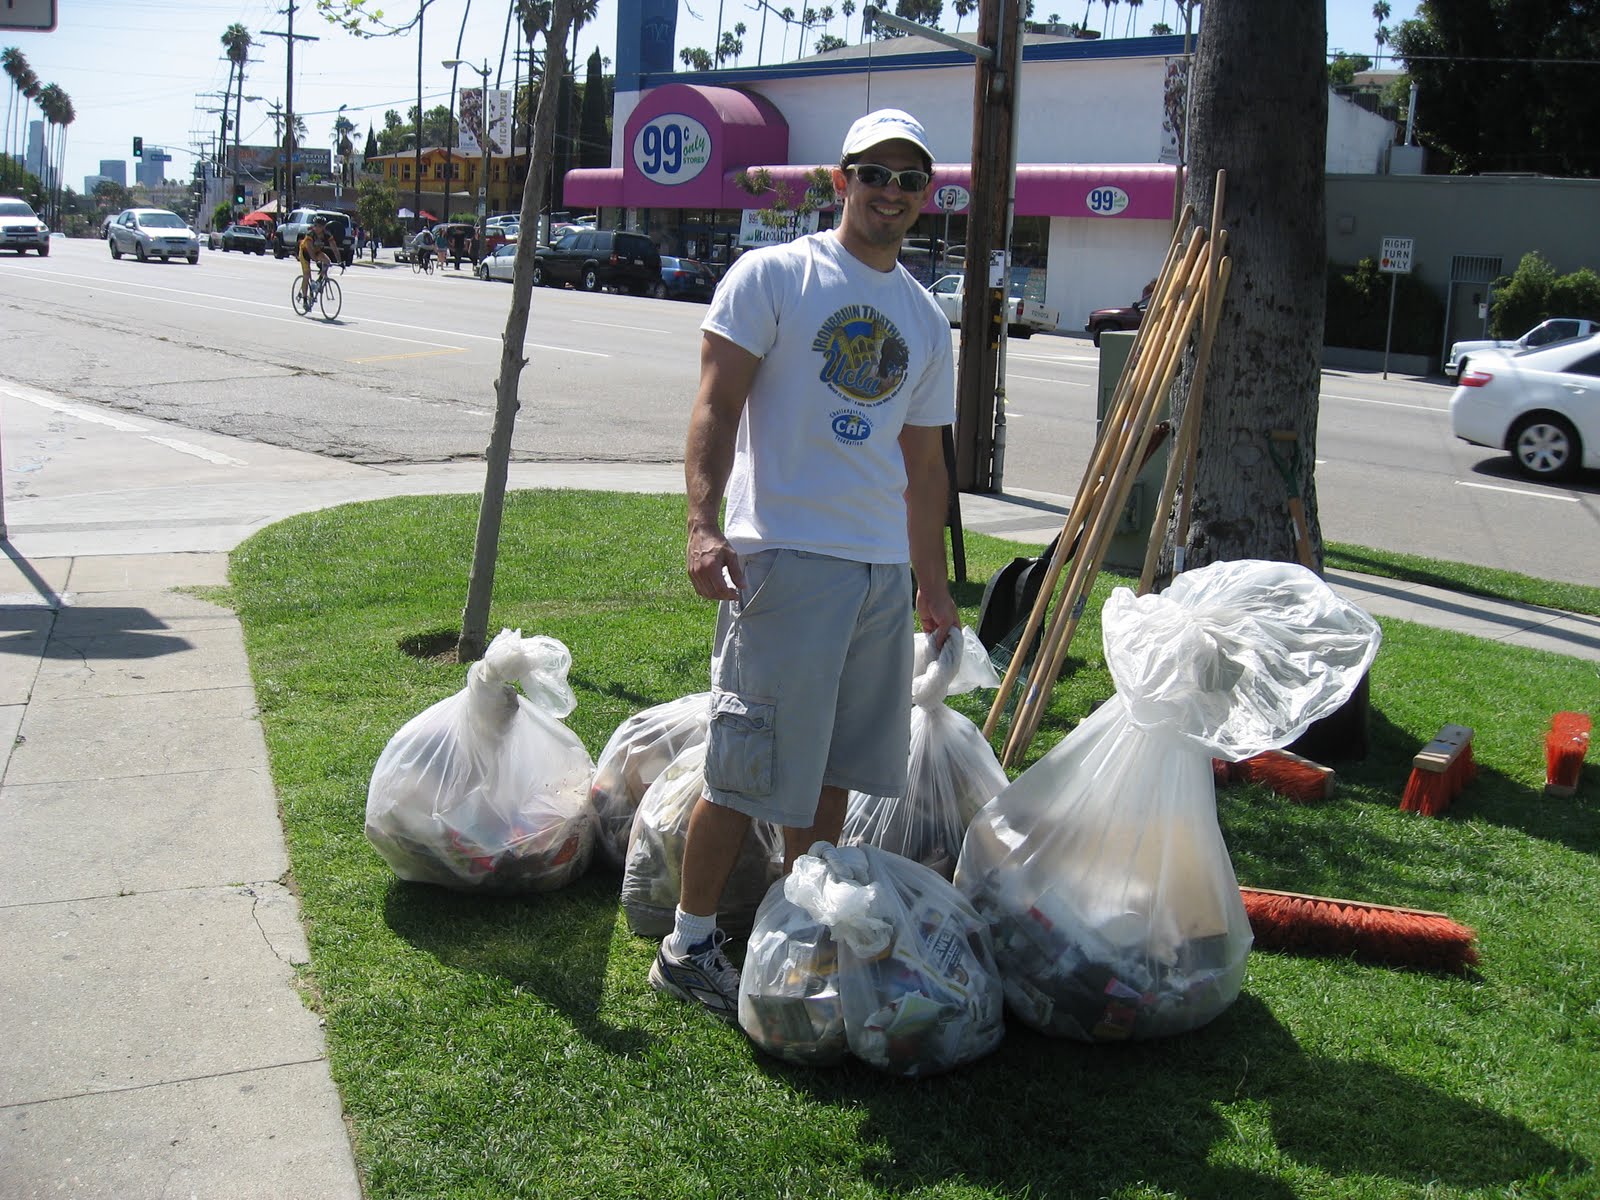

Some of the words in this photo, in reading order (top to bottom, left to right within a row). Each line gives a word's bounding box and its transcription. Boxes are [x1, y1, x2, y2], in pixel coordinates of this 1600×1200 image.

[500, 92, 508, 117] CAVE
[683, 134, 706, 156] only
[683, 156, 705, 165] STORES
[1384, 240, 1412, 249] RIGHT
[1384, 250, 1409, 259] TURN
[1382, 258, 1408, 269] NLY
[812, 305, 860, 352] IRONBRUIN
[836, 420, 867, 437] CAF
